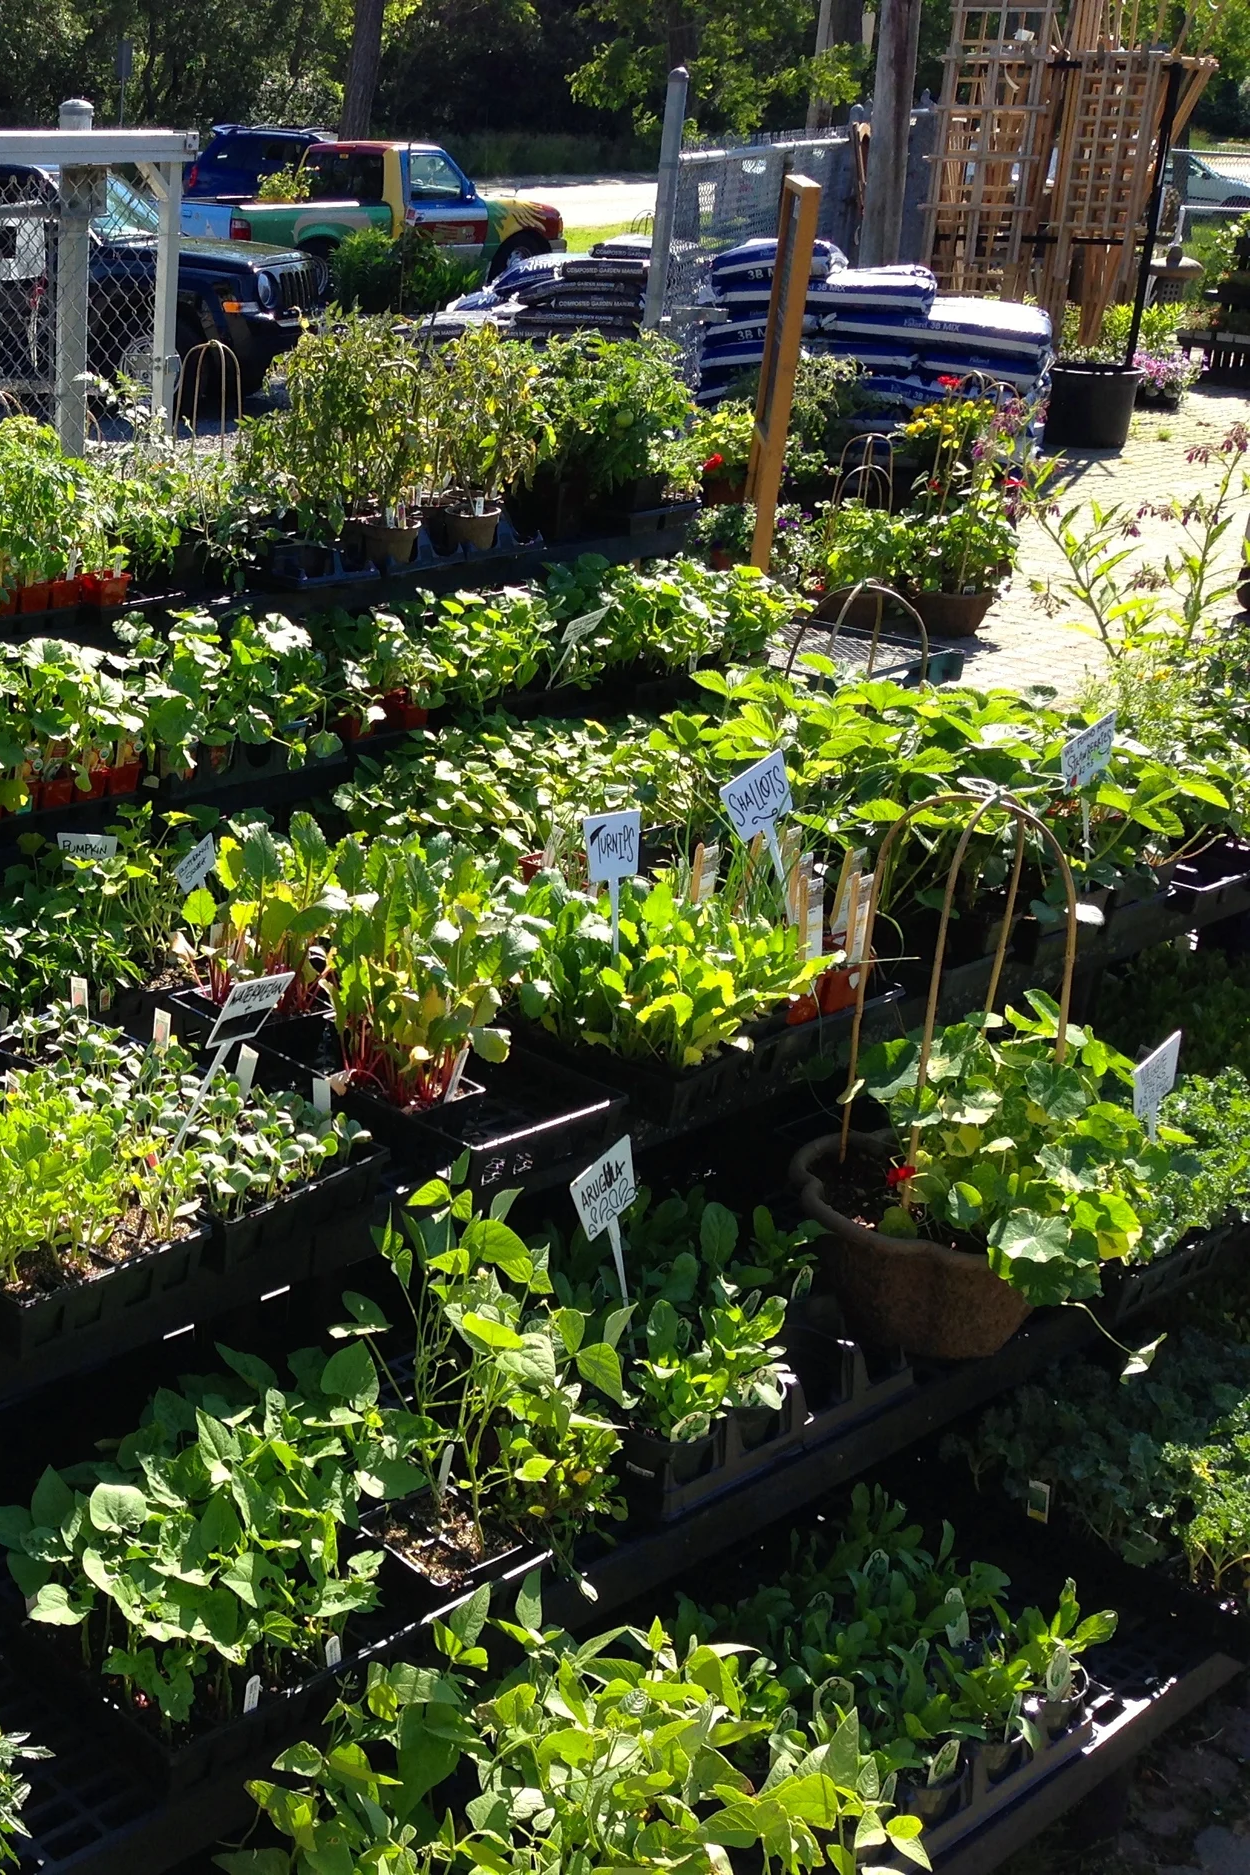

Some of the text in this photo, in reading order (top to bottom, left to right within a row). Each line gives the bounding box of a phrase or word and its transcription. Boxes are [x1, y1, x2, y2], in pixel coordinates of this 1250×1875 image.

[566, 266, 599, 274] COMPOSTED
[747, 268, 764, 281] 3B
[816, 283, 846, 293] 3B MIX
[930, 321, 941, 330] 3B
[942, 321, 960, 332] MIX
[737, 329, 754, 341] 3B
[728, 765, 785, 827] SHALLOTS
[62, 839, 108, 856] PUMPKIN
[589, 823, 635, 864] TURNIPS
[581, 1160, 626, 1211] ARUGULA
